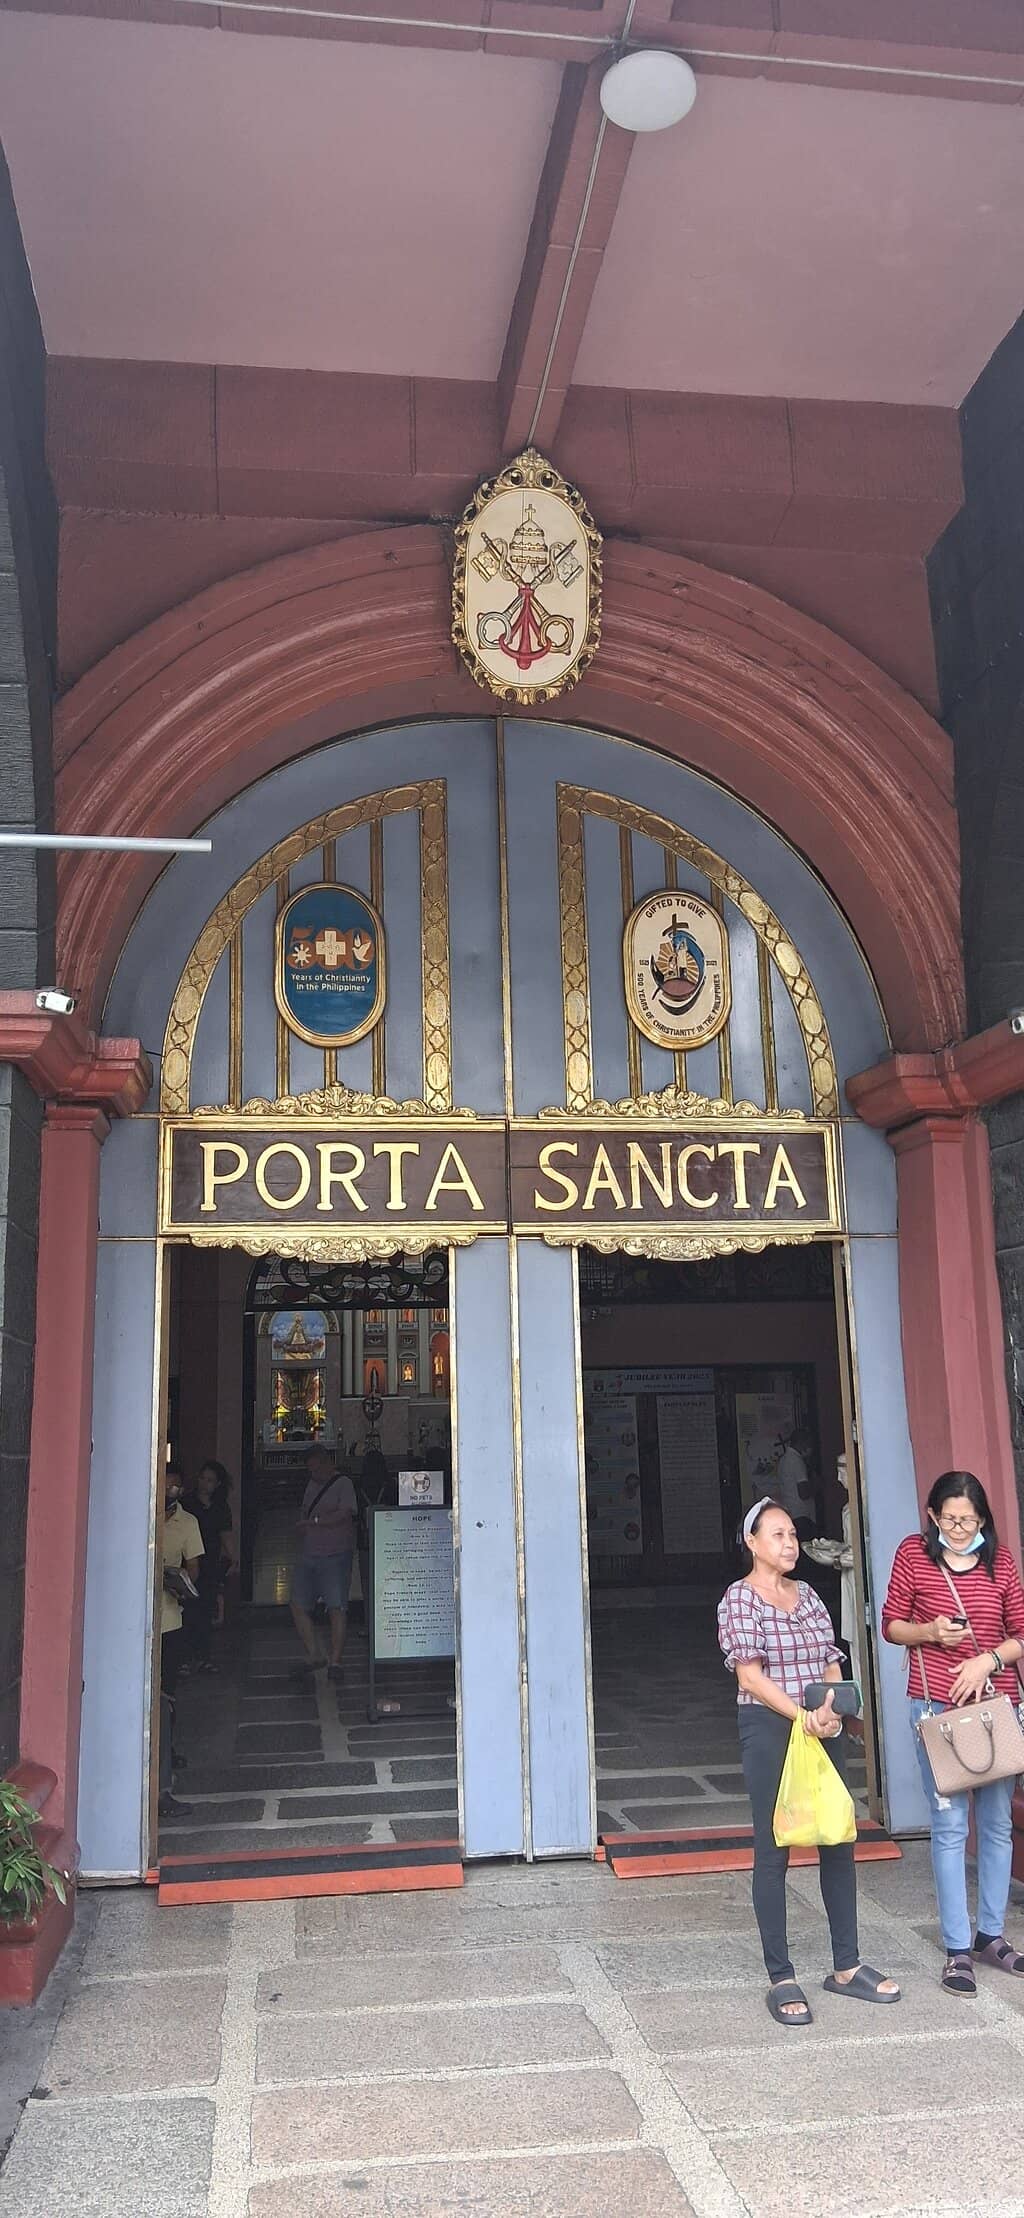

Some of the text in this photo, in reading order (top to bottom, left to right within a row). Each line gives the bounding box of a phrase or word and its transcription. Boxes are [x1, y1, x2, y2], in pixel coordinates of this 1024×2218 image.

[645, 899, 707, 919] GIFTED TO GIVE
[296, 982, 366, 993] in the Philippines
[325, 974, 371, 984] Christianity
[638, 988, 649, 1011] YEARS
[646, 1011, 655, 1020] OF
[653, 1020, 696, 1036] CHRISTIANITY
[696, 1025, 705, 1033] IN
[703, 1014, 716, 1027] THE
[200, 1142, 807, 1211] PORTA SANCTA
